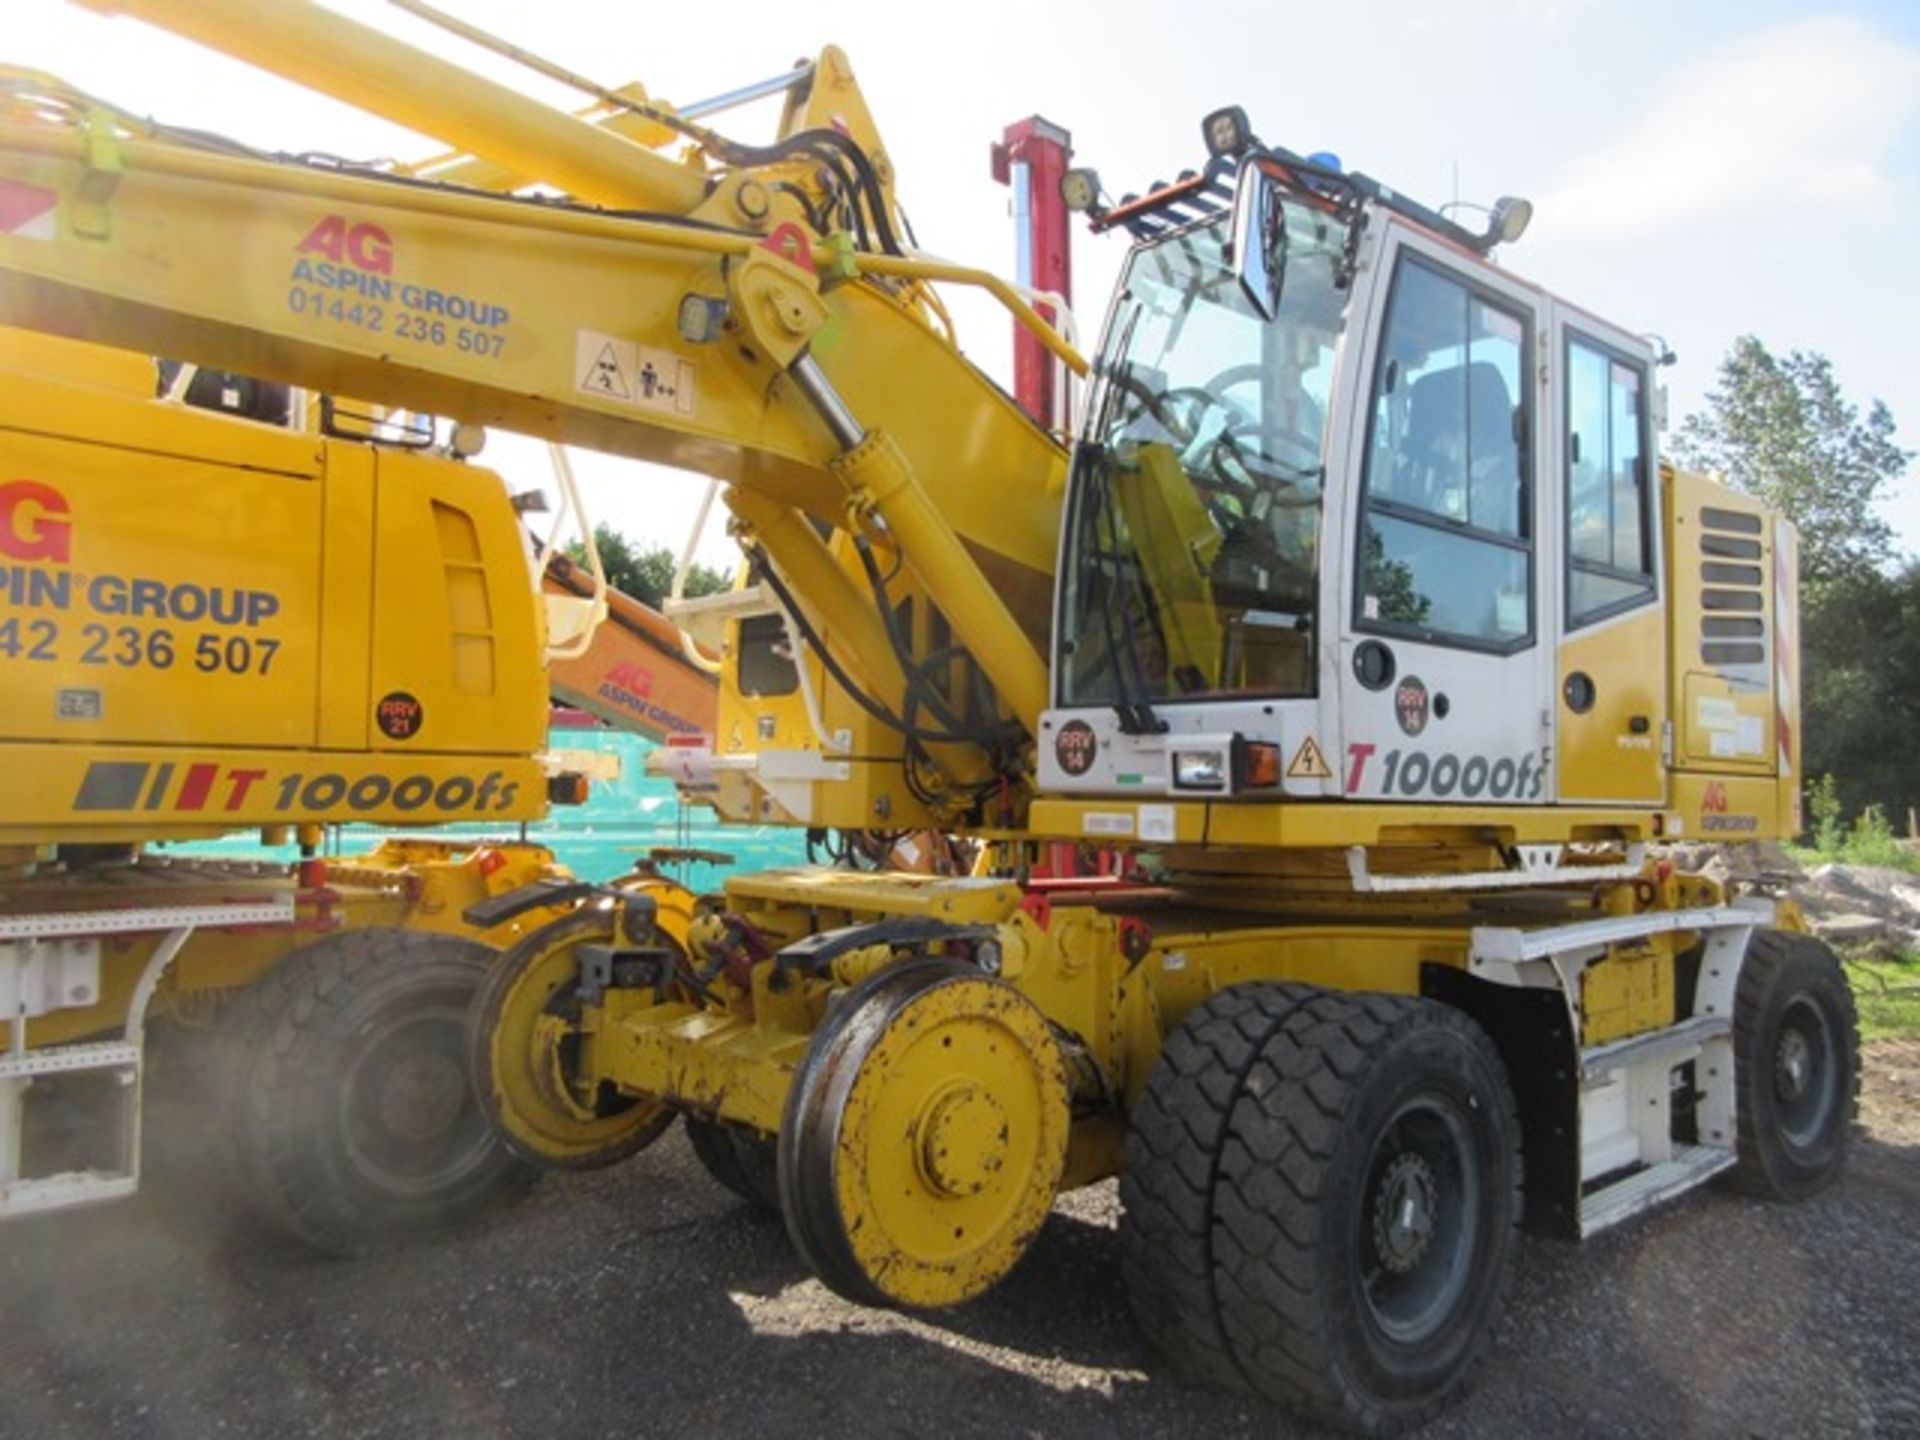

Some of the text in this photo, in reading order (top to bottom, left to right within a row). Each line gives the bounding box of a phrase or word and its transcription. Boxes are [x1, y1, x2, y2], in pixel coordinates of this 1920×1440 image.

[296, 214, 394, 276] AG
[292, 257, 509, 328] ASPIN GROUP
[288, 286, 506, 358] 01442 236 507
[88, 574, 280, 627] GROUP
[80, 623, 175, 669] 236
[194, 633, 281, 676] 507
[606, 661, 654, 699] AG
[382, 701, 418, 717] RRV
[389, 718, 409, 734] 21
[1059, 731, 1093, 749] RRV
[224, 770, 519, 812] T 10000fs
[1346, 743, 1545, 799] T 10000fs
